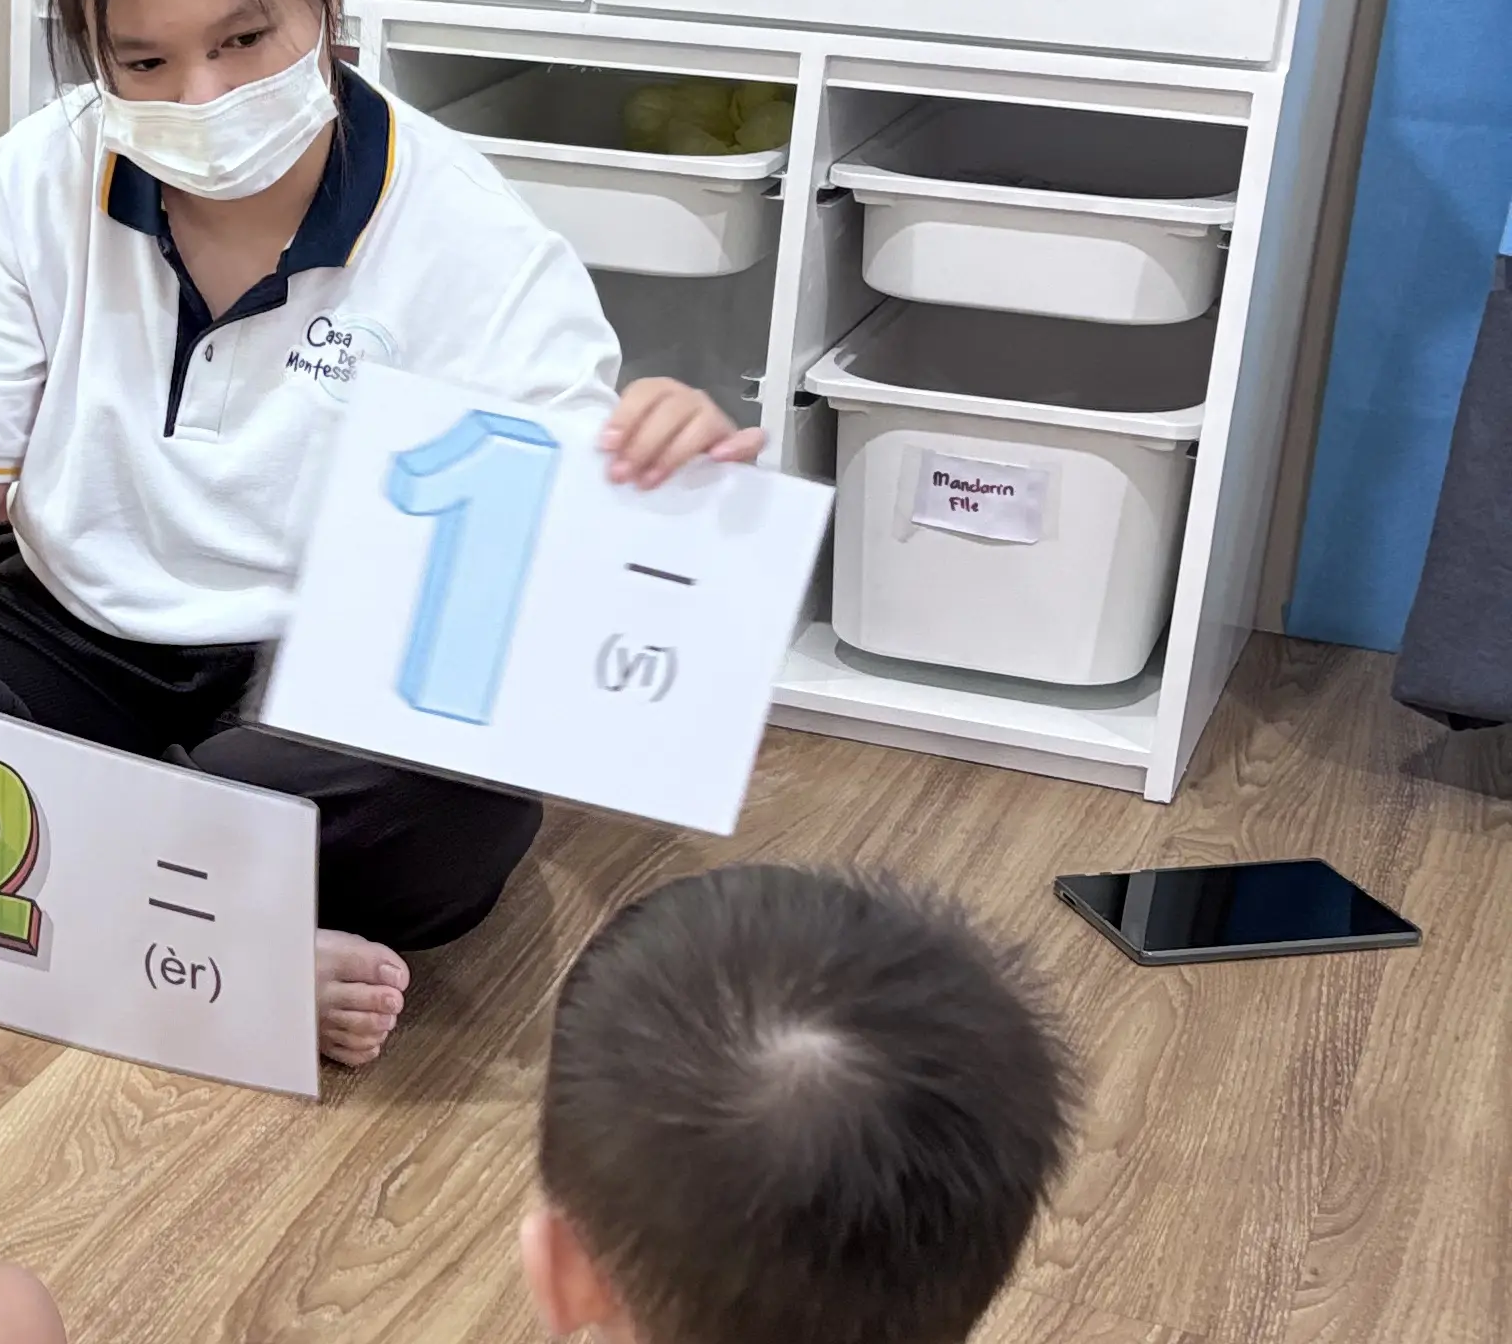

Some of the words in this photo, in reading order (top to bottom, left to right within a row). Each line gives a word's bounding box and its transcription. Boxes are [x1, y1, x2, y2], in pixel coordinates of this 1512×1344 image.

[306, 315, 353, 349] Casa
[932, 470, 1015, 496] Mandarin
[382, 408, 562, 727] 1
[145, 941, 222, 1004] (èr)
